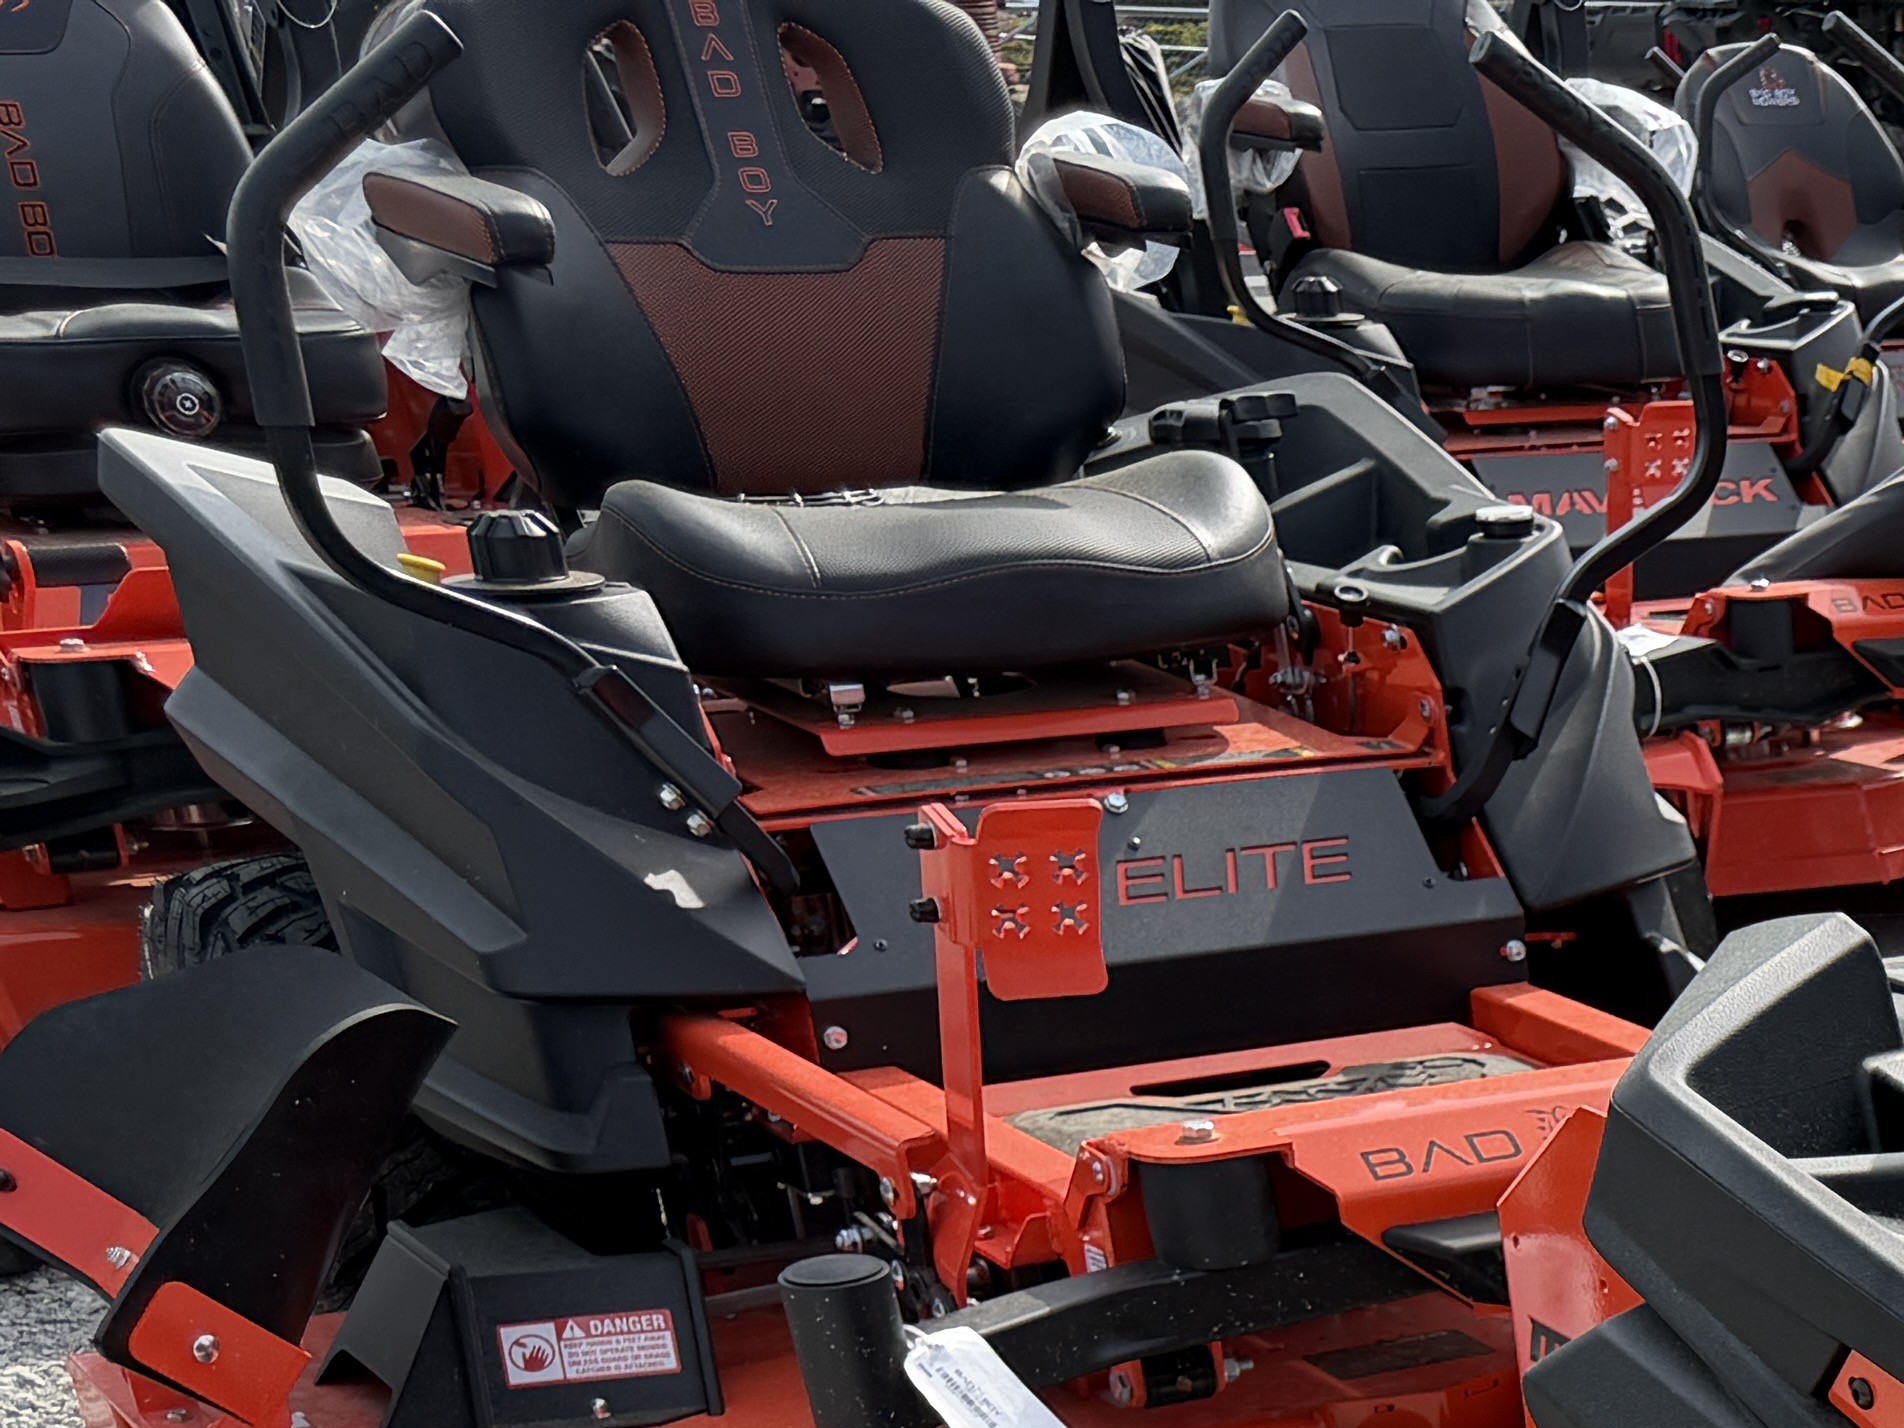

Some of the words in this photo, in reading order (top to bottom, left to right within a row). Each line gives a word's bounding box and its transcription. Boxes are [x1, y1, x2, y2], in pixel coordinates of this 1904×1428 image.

[688, 0, 742, 98] BAD
[727, 131, 778, 226] BOY
[18, 200, 58, 258] BO
[1115, 837, 1352, 906] ELITE
[1360, 1129, 1523, 1182] BAD
[589, 1314, 666, 1335] DANGER
